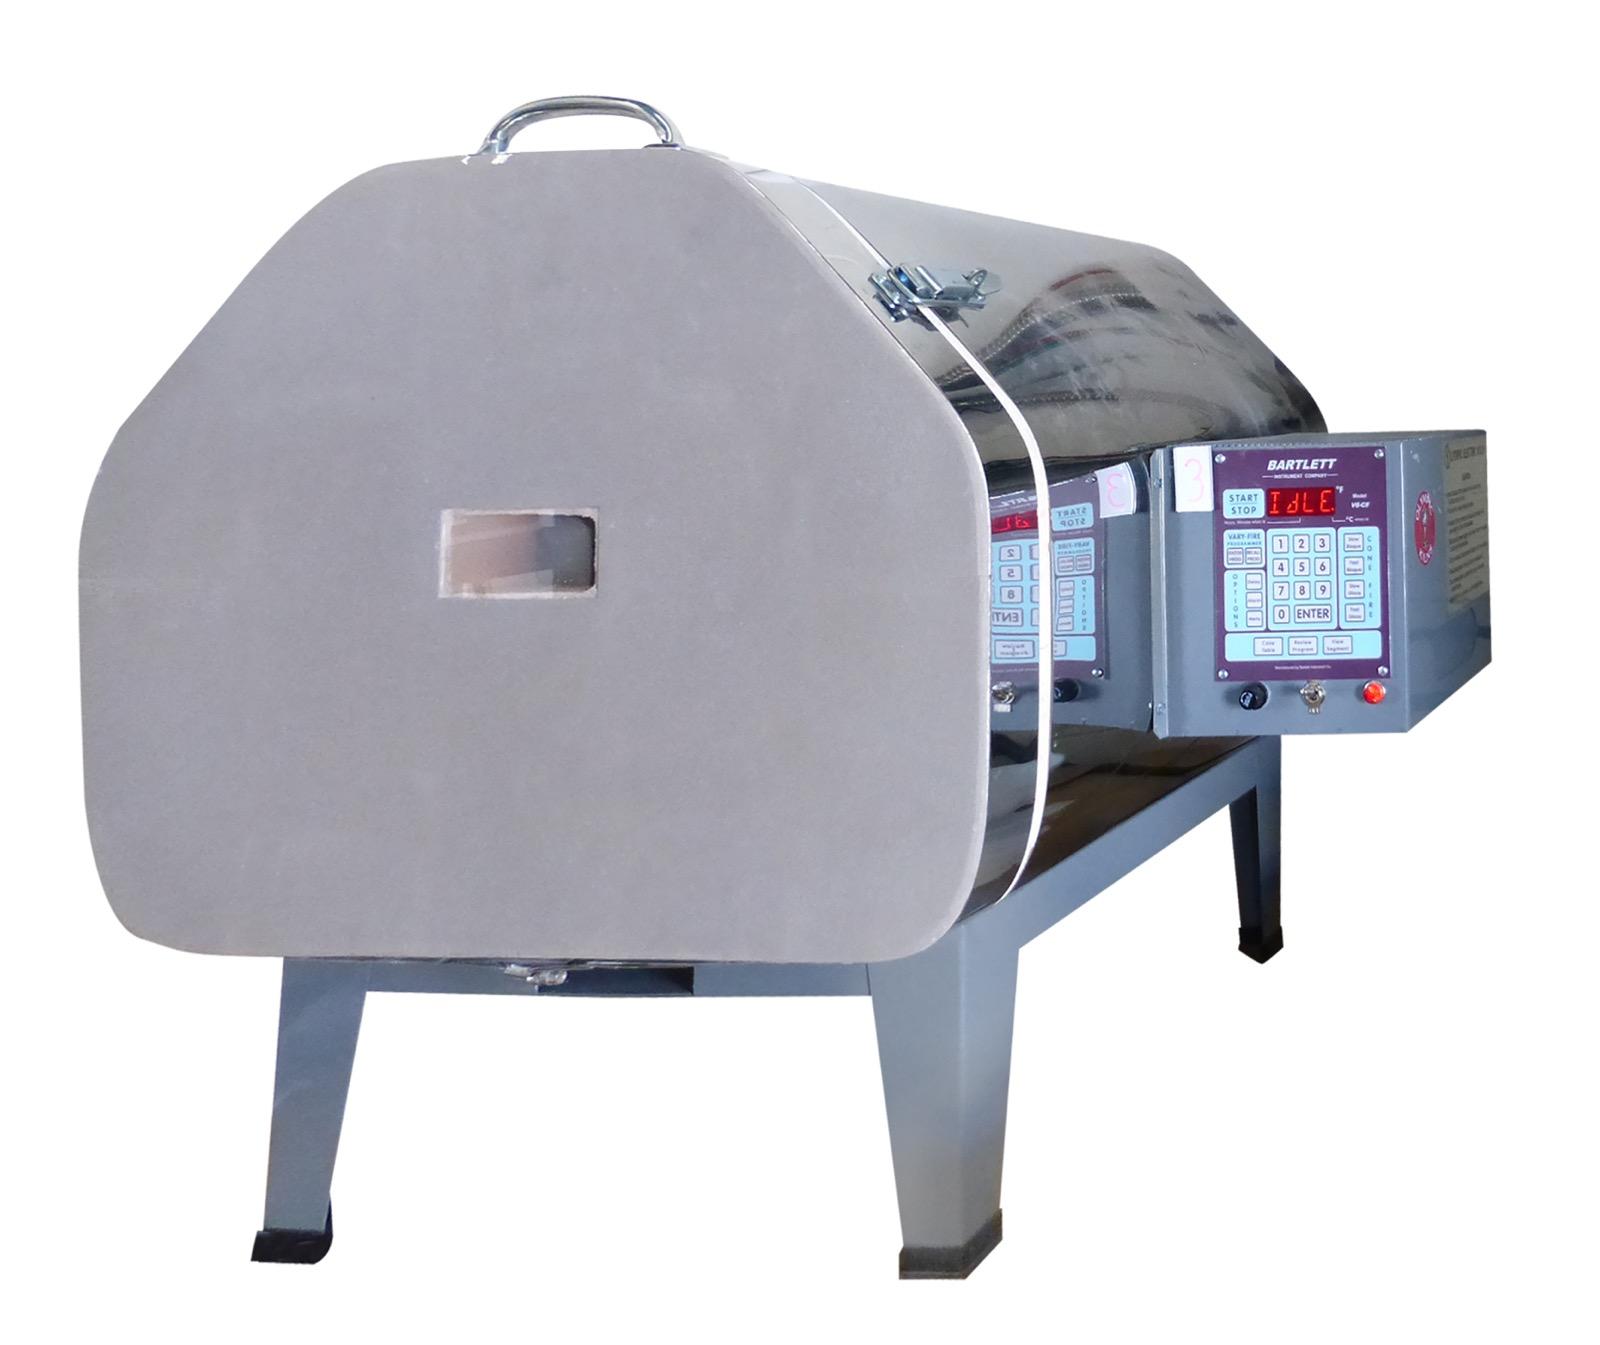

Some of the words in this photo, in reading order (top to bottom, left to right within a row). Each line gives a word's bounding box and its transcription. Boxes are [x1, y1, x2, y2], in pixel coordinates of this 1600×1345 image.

[1267, 458, 1337, 471] BARTLETT
[1229, 494, 1258, 503] START
[1231, 506, 1257, 515] STOP
[1278, 538, 1283, 548] 1
[1298, 538, 1305, 549] 2
[1318, 537, 1326, 548] 3
[1278, 562, 1284, 572] 4
[1299, 562, 1305, 572] 5
[1319, 561, 1326, 572] 6
[1278, 586, 1285, 596] 7
[1299, 585, 1305, 596] 8
[1319, 584, 1327, 595] 9
[1278, 609, 1285, 619] 0
[1297, 607, 1329, 619] ENTER
